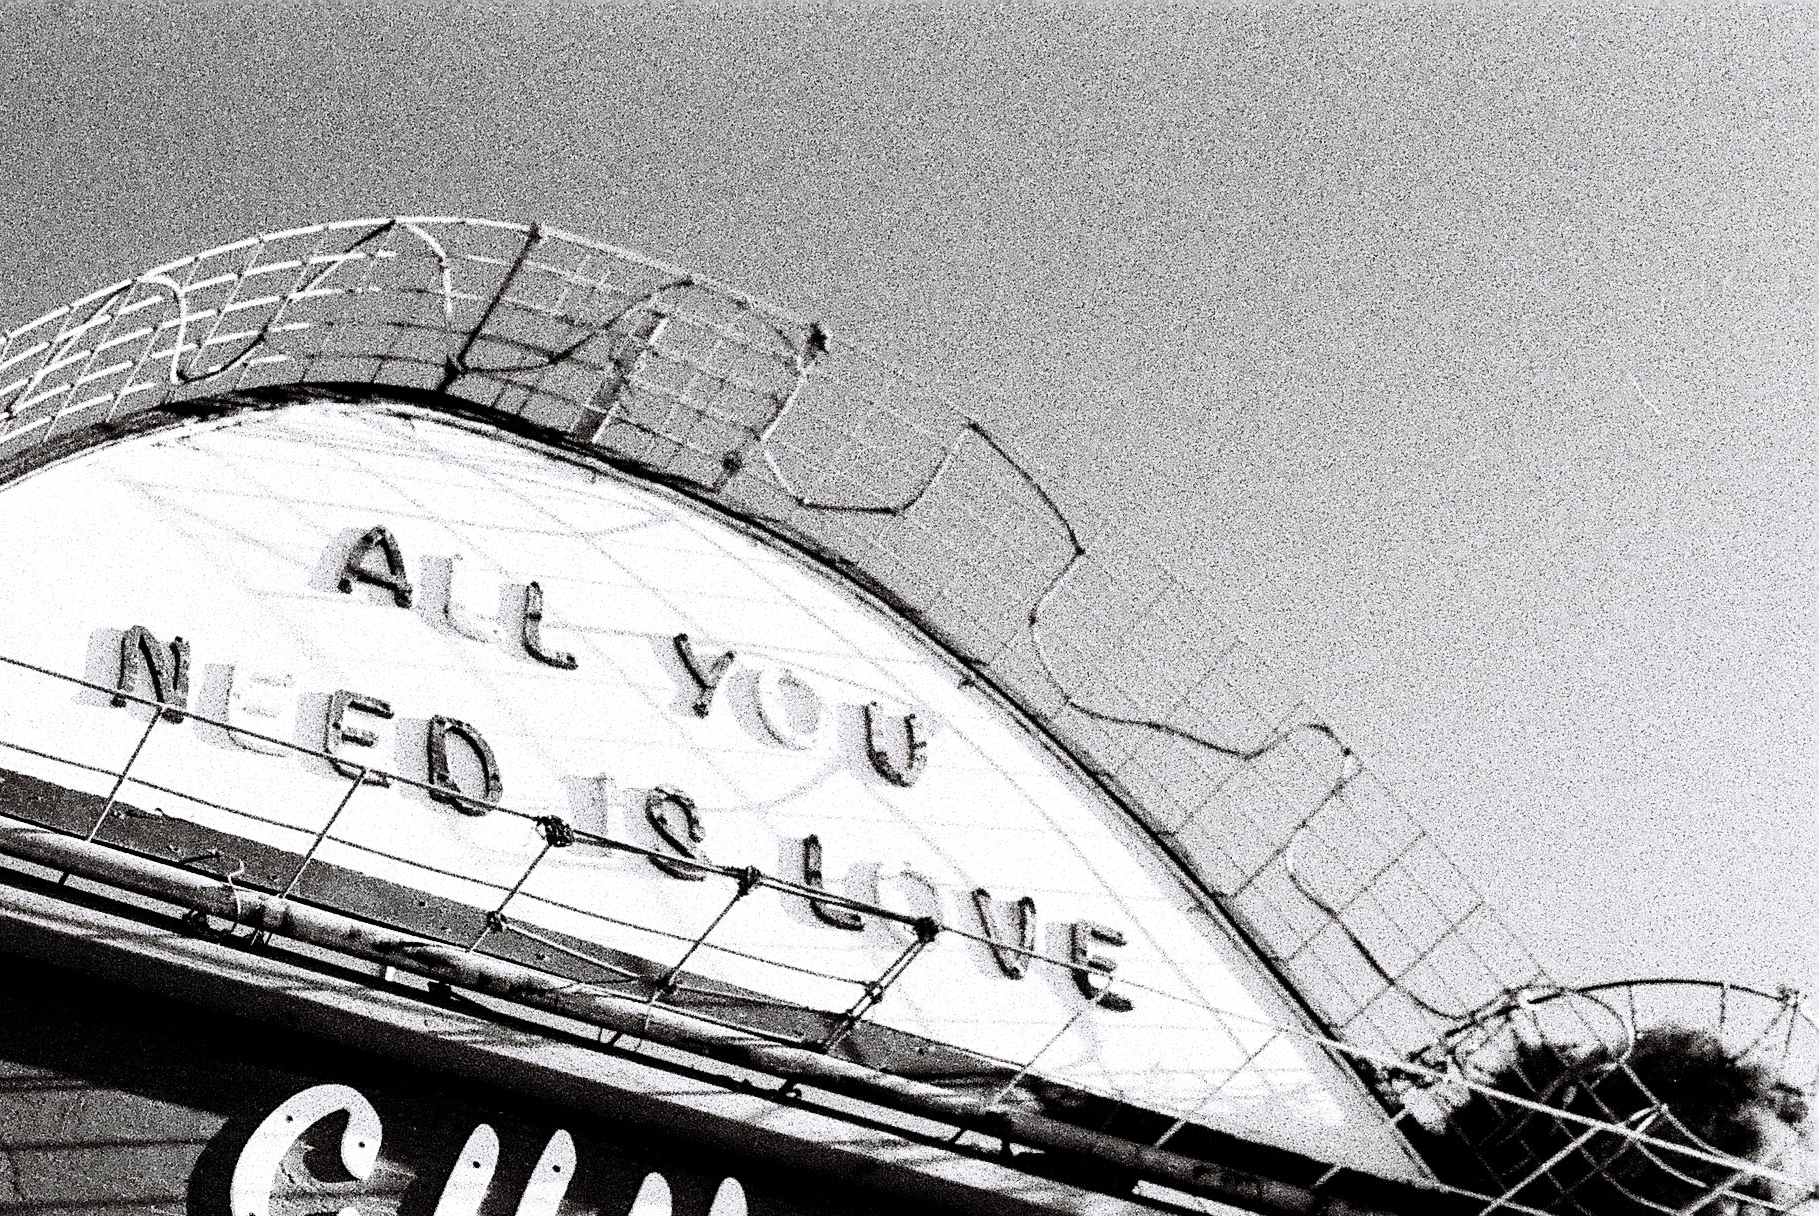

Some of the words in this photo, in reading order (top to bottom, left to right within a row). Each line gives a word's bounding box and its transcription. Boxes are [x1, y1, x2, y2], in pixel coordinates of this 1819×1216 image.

[110, 622, 504, 818] NEED
[582, 770, 708, 882] IS
[801, 832, 1134, 1013] LOVE
[337, 524, 578, 671] ALL
[672, 632, 930, 788] YOU
